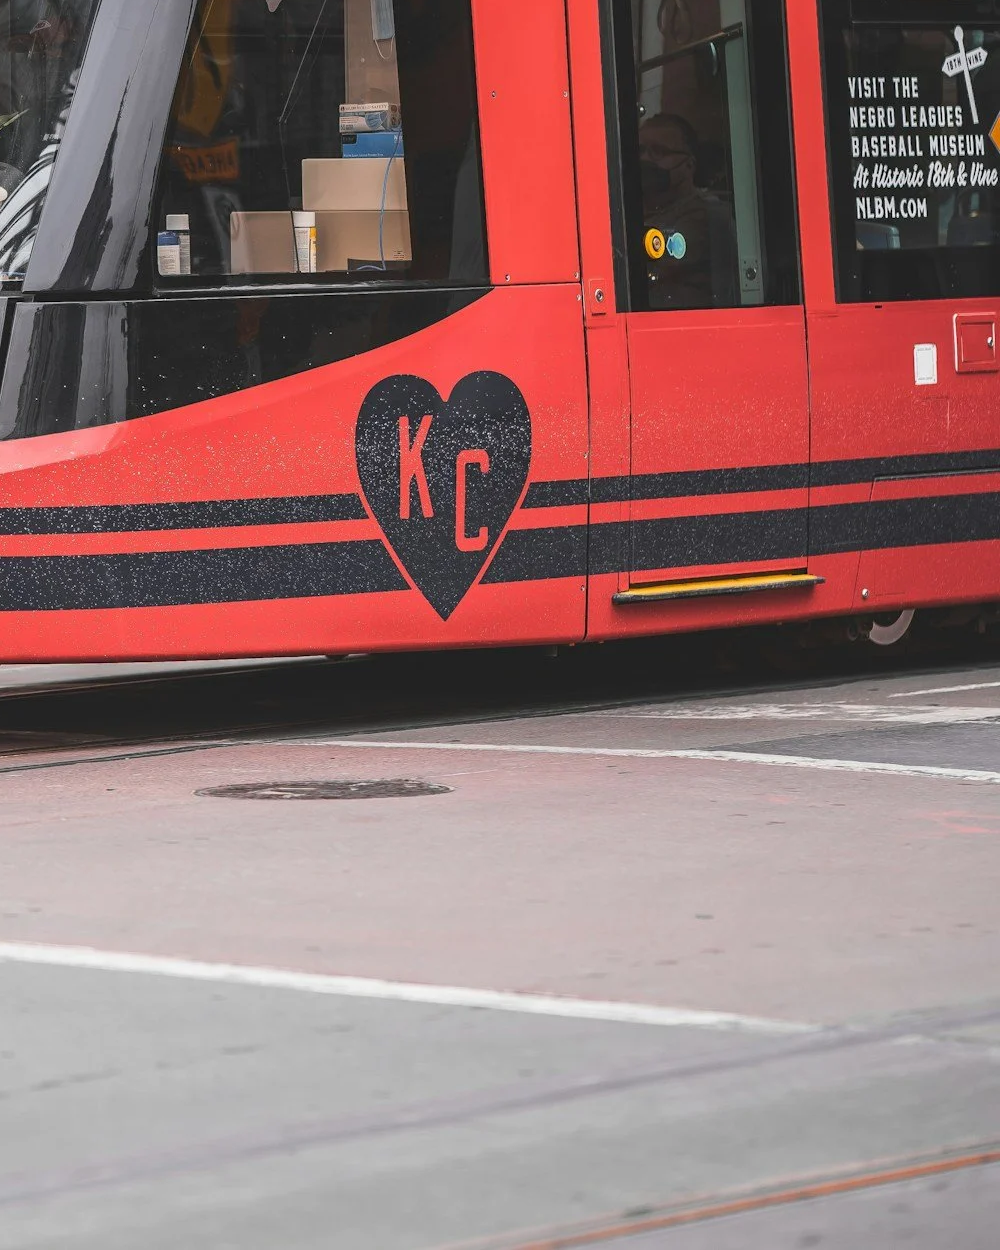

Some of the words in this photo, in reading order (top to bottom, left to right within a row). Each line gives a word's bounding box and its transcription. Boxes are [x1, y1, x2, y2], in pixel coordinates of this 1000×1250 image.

[967, 52, 983, 66] VINE
[848, 77, 885, 98] VISIT
[893, 77, 919, 98] THE
[850, 106, 895, 128] NEGRO
[902, 106, 963, 128] LEAGUES
[851, 135, 923, 158] BASEBALL
[929, 134, 985, 157] MUSEUM
[853, 163, 869, 189] At
[871, 162, 924, 189] Historic
[927, 160, 955, 188] 18th
[956, 161, 968, 186] &
[970, 162, 999, 187] Vine
[856, 196, 928, 219] NLBM.COM
